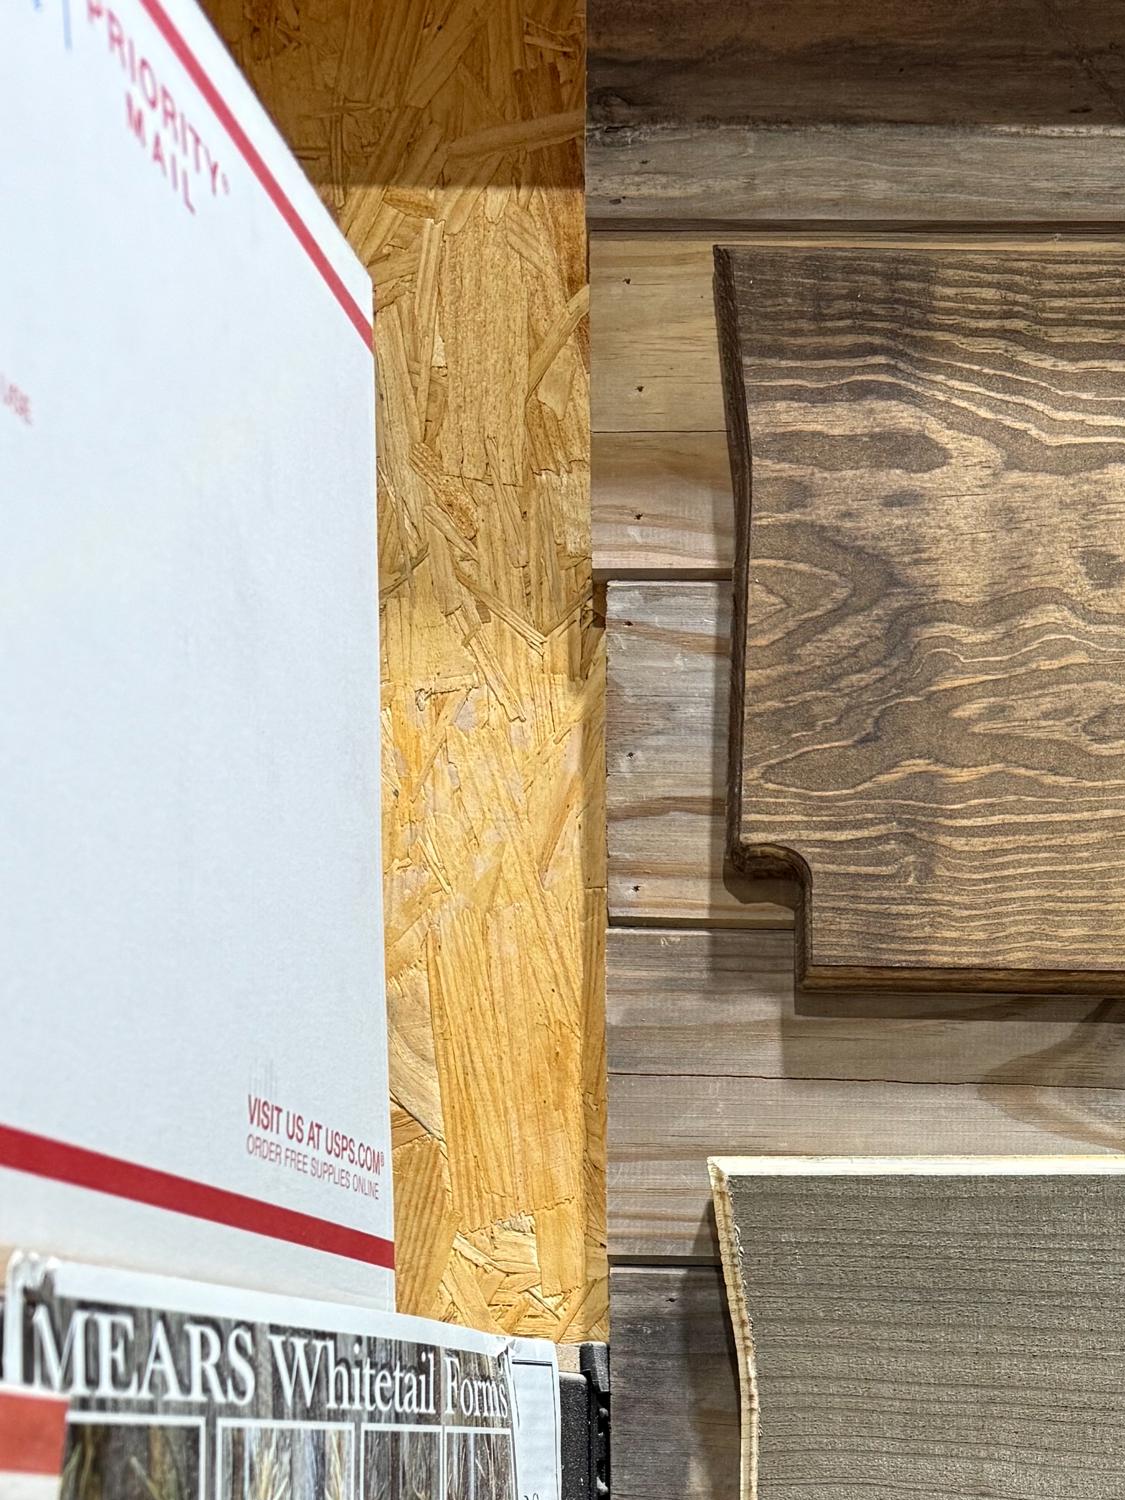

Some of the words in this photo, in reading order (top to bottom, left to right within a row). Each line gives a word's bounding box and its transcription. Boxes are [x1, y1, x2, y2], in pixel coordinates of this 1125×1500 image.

[126, 91, 196, 215] MAIL
[247, 1134, 281, 1166] ORDER
[285, 1148, 308, 1174] FREE
[310, 1158, 350, 1190] SUPPLIES
[353, 1175, 379, 1200] ONLINE
[248, 1094, 282, 1135] VISIT
[286, 1111, 304, 1143] US
[307, 1121, 322, 1150] AT
[33, 1304, 256, 1407] MEARS
[268, 1335, 436, 1415] Whitetail
[444, 1356, 508, 1419] Forms
